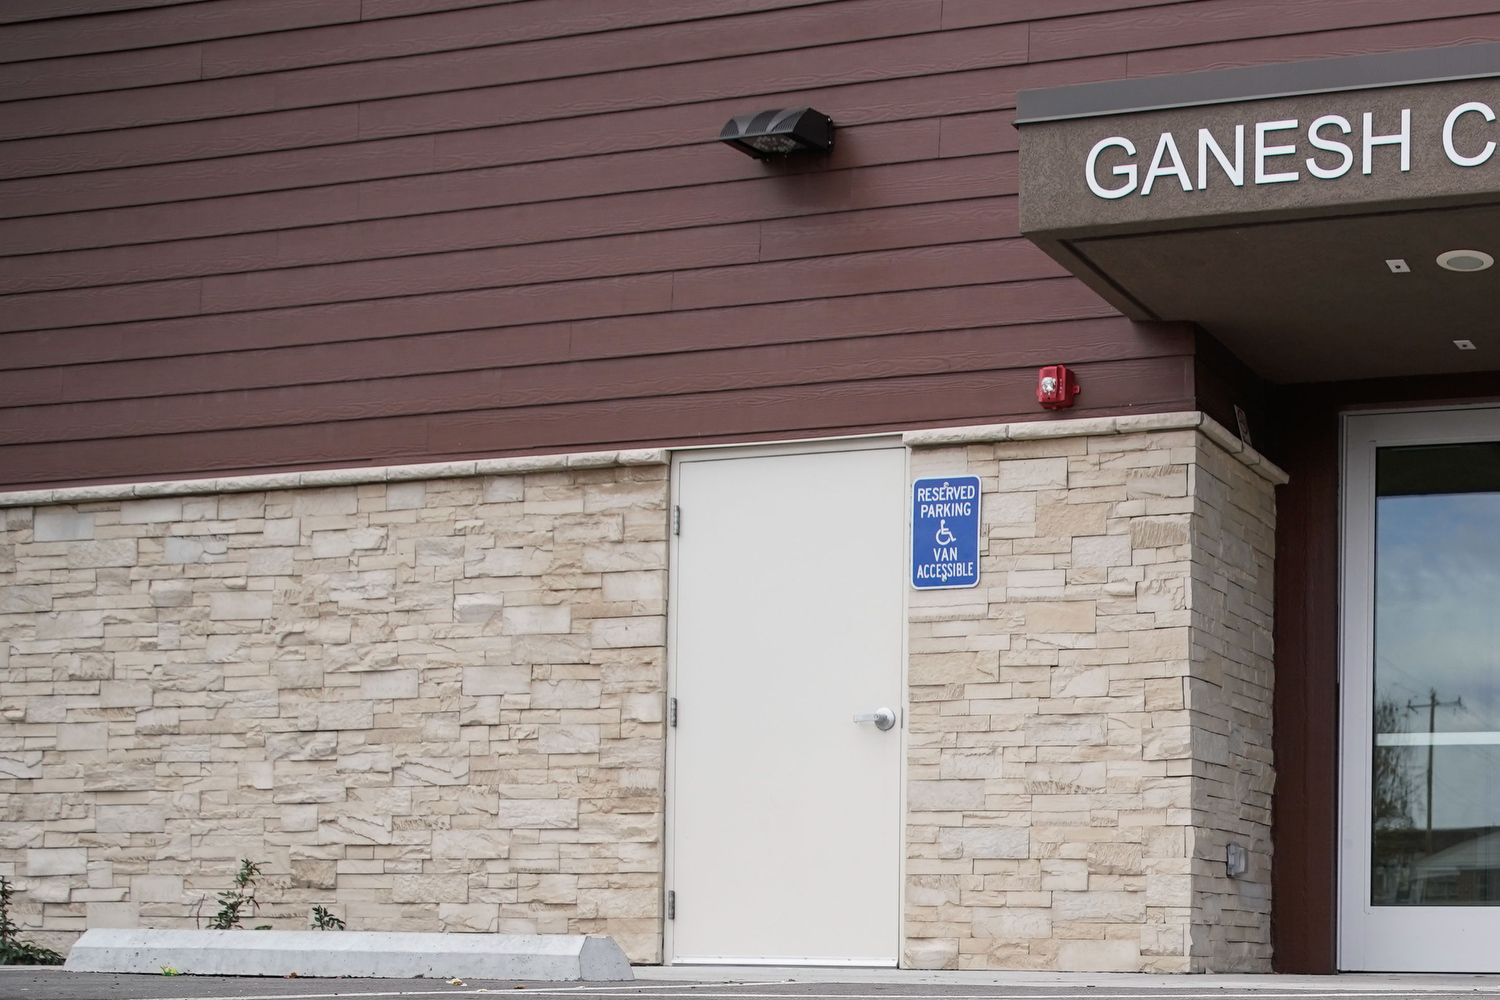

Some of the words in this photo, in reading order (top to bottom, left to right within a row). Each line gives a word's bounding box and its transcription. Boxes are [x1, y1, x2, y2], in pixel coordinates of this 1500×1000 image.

[1084, 109, 1412, 199] GANESH
[917, 485, 976, 503] RESERVED
[920, 502, 972, 519] PARKING
[933, 547, 958, 562] VAN
[916, 562, 974, 579] ACCESSIBLE
